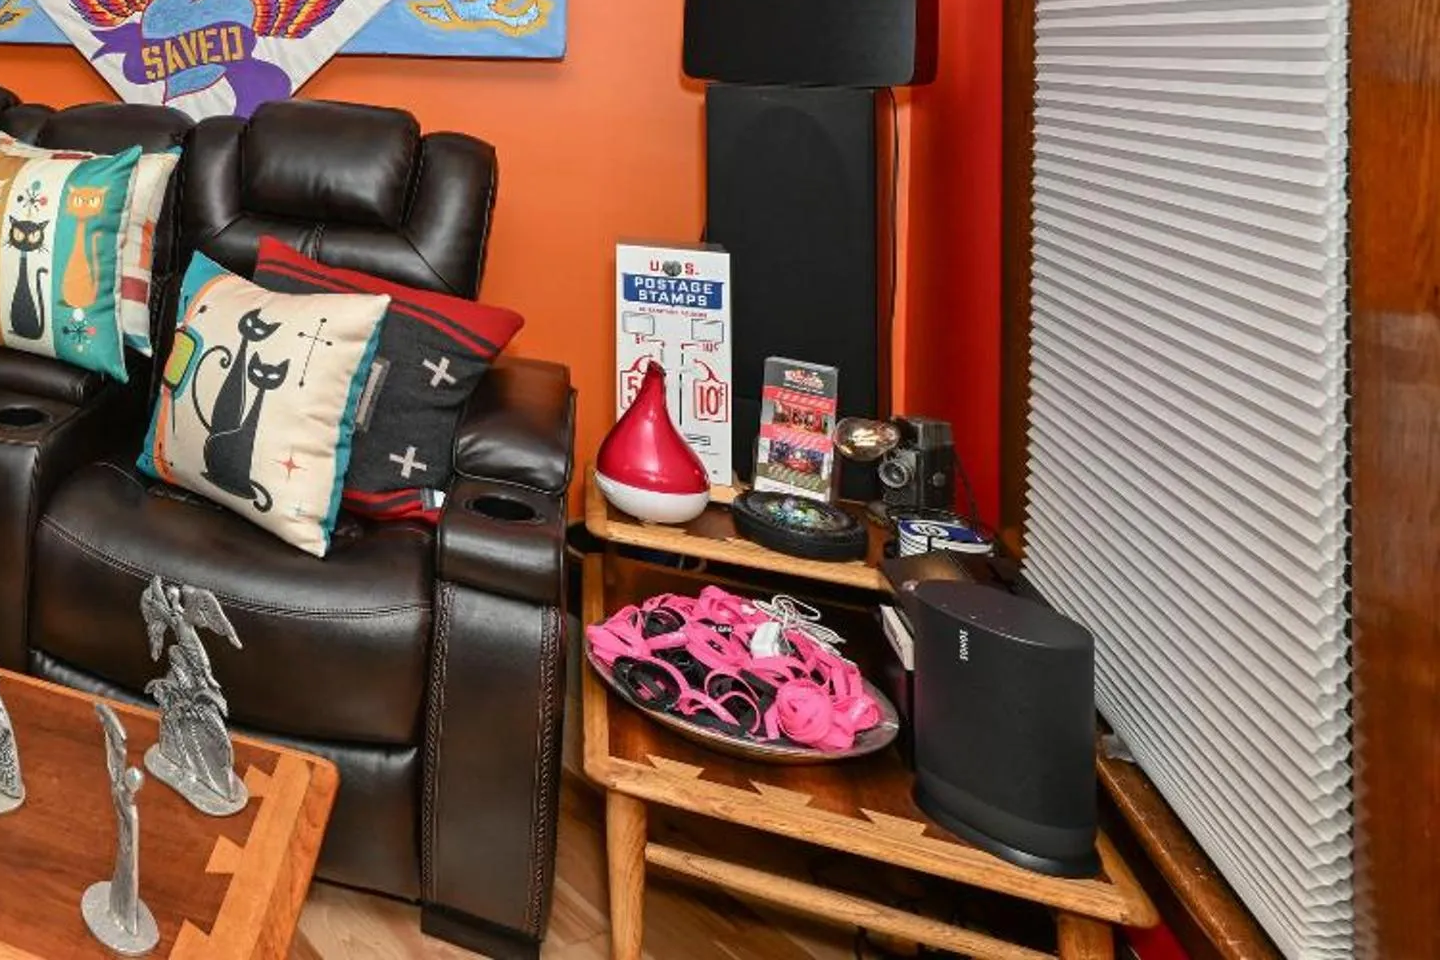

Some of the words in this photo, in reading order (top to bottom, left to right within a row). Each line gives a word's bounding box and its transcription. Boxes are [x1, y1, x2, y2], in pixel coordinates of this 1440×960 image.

[141, 25, 244, 80] SAVED
[634, 276, 714, 296] POSTAGE
[638, 289, 708, 307] STAMPS
[959, 629, 969, 662] SONOS
